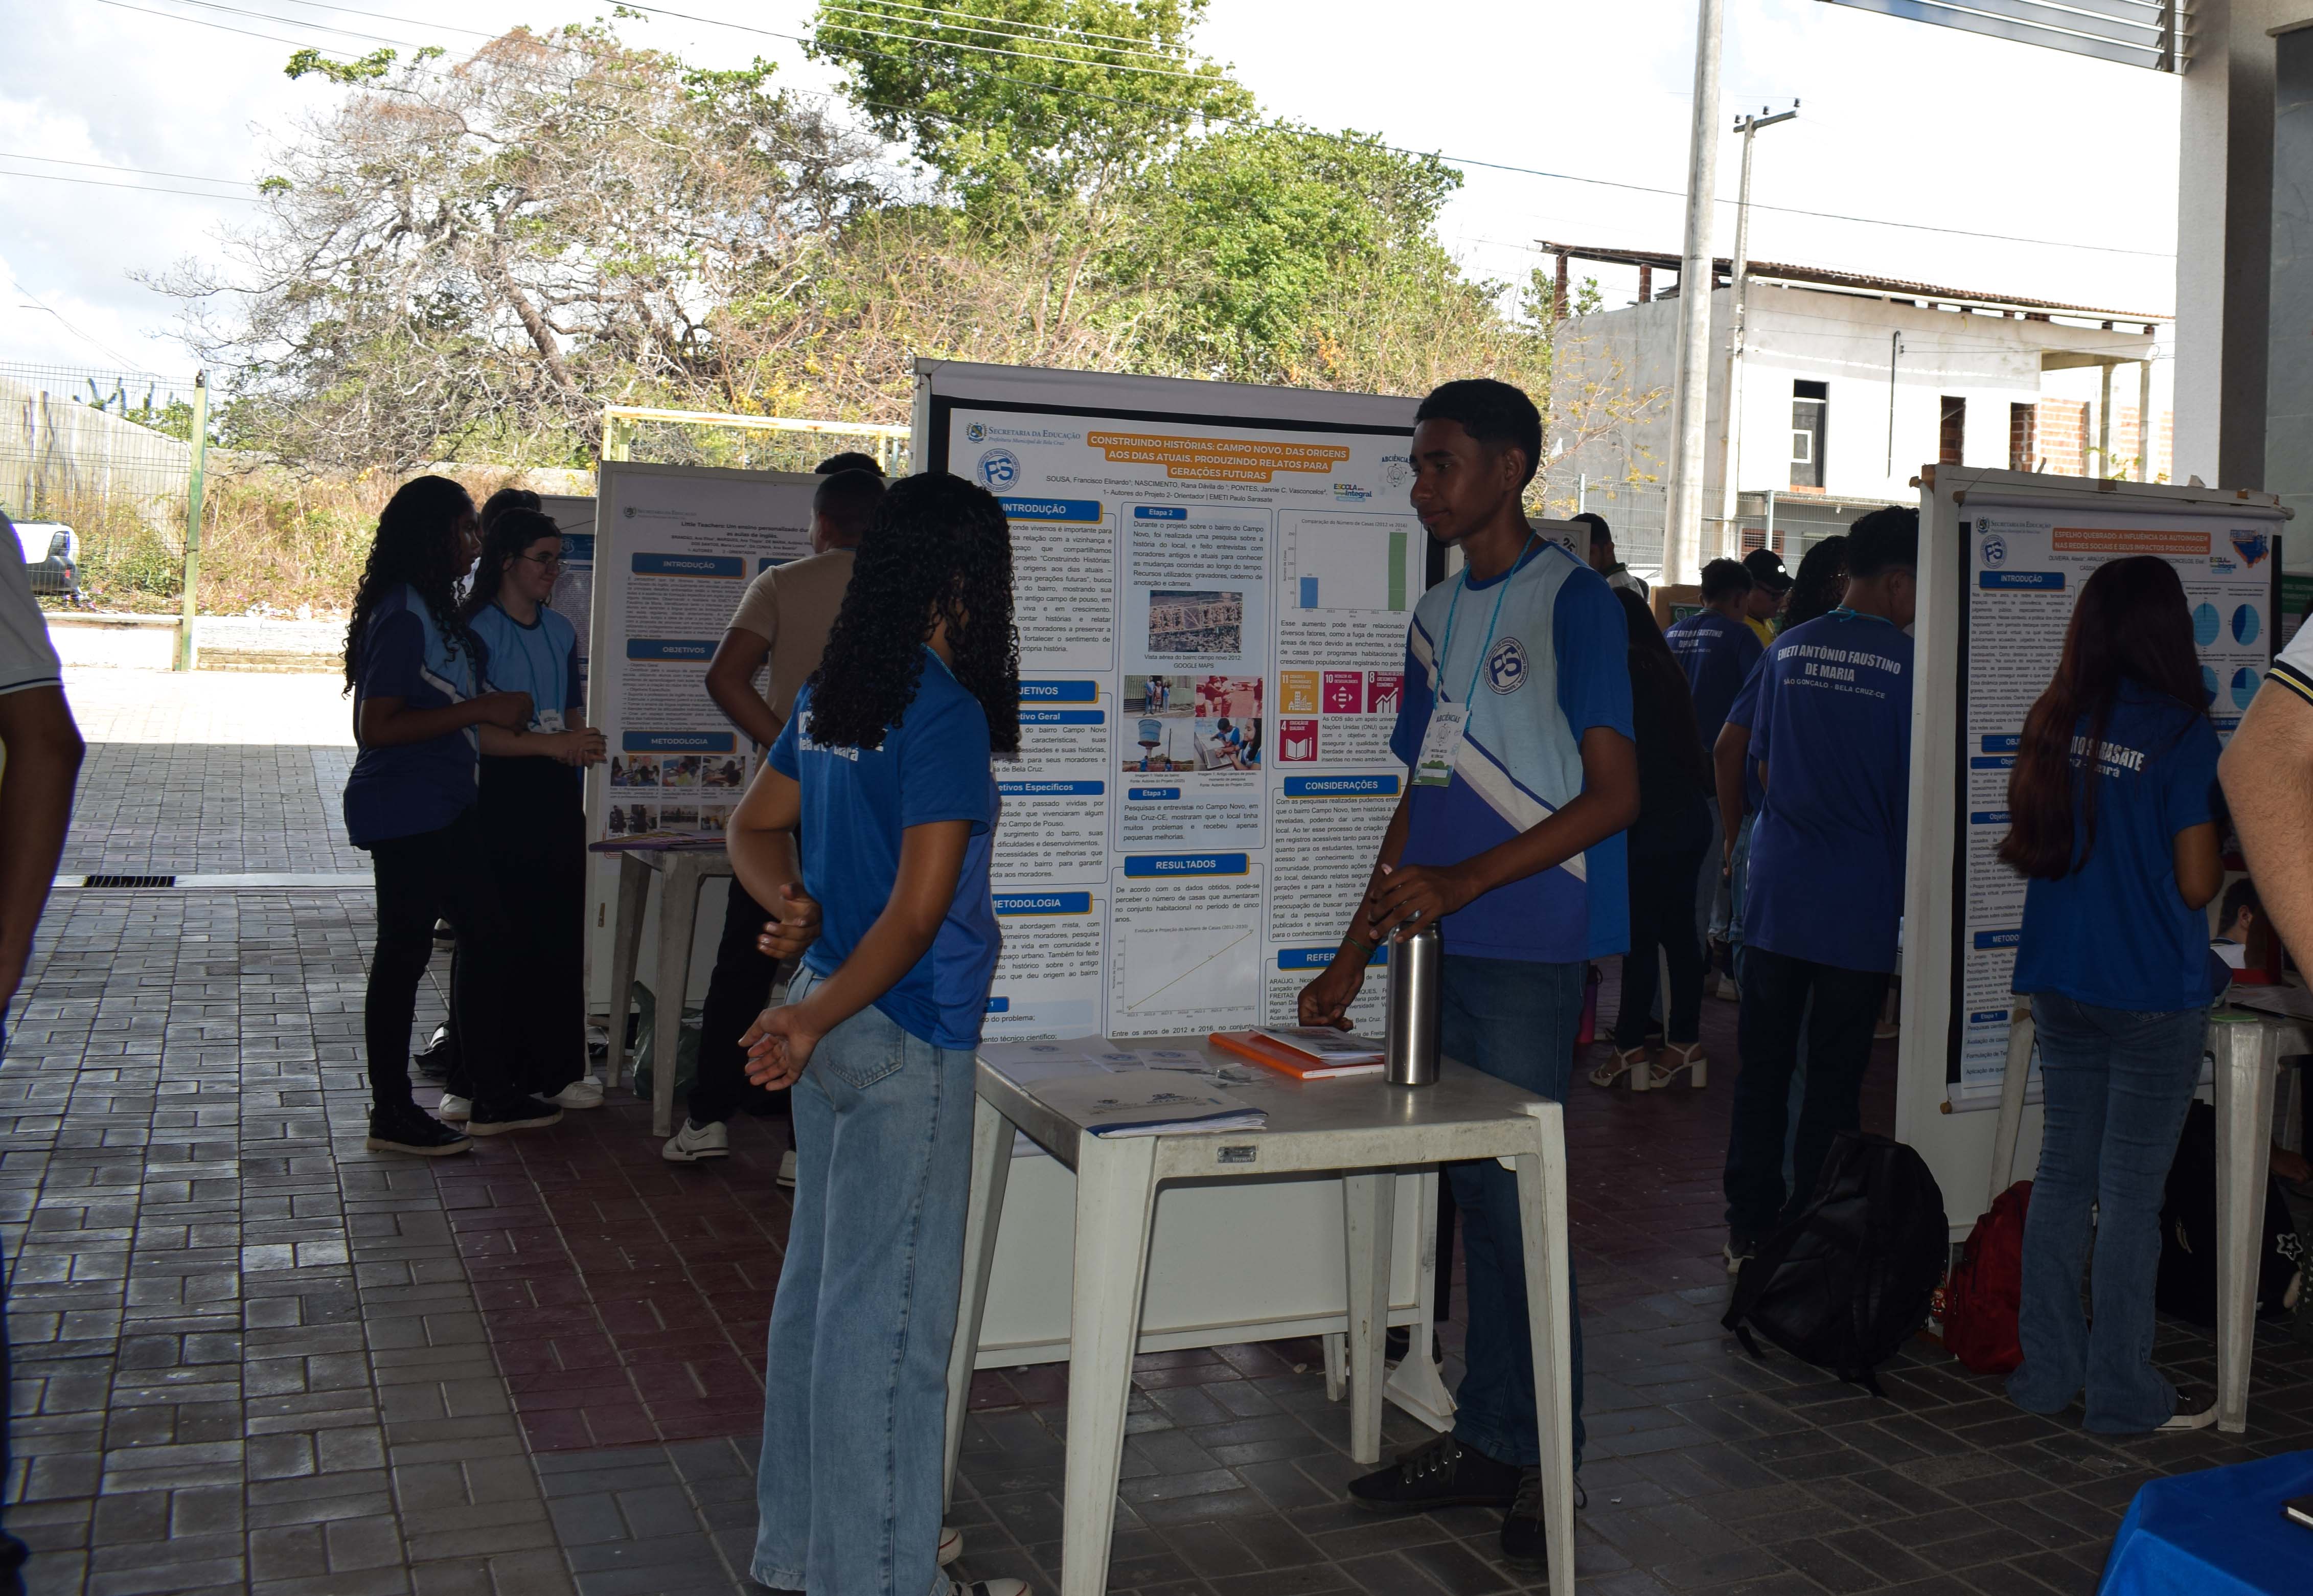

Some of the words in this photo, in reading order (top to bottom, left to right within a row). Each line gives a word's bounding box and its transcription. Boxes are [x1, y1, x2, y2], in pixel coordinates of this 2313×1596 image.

[1091, 436, 1161, 447] CONSTRUINDO
[1164, 440, 1215, 450] HISTÓRIAS:
[1217, 443, 1251, 452] CAMPO
[1286, 447, 1304, 455] DAS
[1307, 449, 1346, 458] ORIGENS
[1109, 450, 1130, 459] AOS
[1132, 452, 1155, 460] DIAS
[1195, 455, 1257, 466] PRODUZINDO
[1259, 459, 1301, 468] RELATOS
[1303, 462, 1329, 470] PARA
[1171, 467, 1221, 478] GERAÇÕES
[1223, 470, 1266, 479] FUTURAS
[1003, 504, 1066, 515] INTRODUÇÃO
[663, 561, 715, 569] INTRODUÇÃO
[2001, 574, 2043, 583] INTRODUÇÃO
[1777, 645, 1798, 661] EMETI
[1799, 645, 1846, 662] ANTÔNIO
[1848, 651, 1901, 674] FAUSTINO
[1369, 672, 1375, 682] 8
[1805, 663, 1818, 676] DE
[1820, 665, 1854, 681] MARIA
[1282, 675, 1288, 683] 11
[1325, 674, 1333, 683] 10
[1796, 679, 1828, 688] GONÇALO
[1835, 684, 1852, 692] BELA
[1855, 687, 1885, 699] CRUZ-CE
[1281, 721, 1287, 731] 4
[1025, 783, 1073, 792] Específicos
[1306, 781, 1378, 790] CONSIDERAÇÕES
[1156, 860, 1216, 869] RESULTADOS
[1002, 1015, 1035, 1023] problema;
